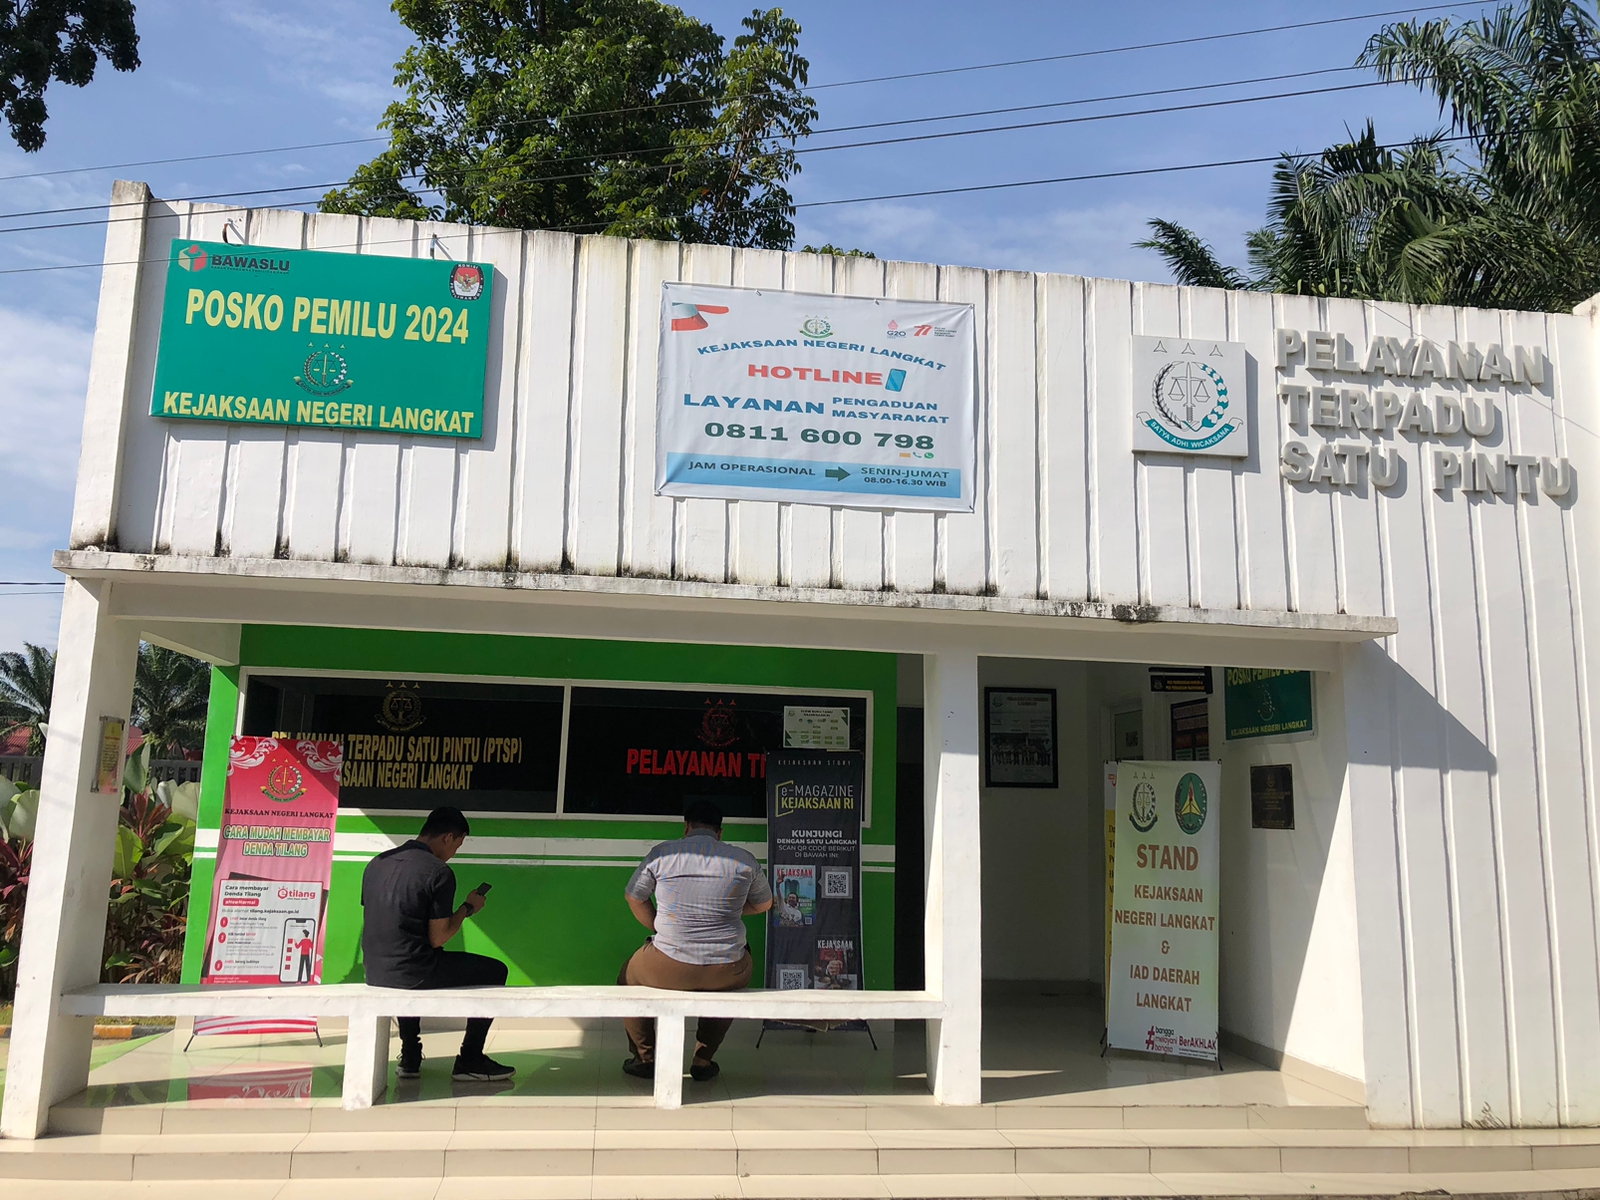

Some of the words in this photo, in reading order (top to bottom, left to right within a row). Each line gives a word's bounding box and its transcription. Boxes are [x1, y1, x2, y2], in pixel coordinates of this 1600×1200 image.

[212, 254, 290, 271] BAWASLU
[185, 288, 284, 331] POSKO
[292, 296, 397, 339] PEMILU
[404, 304, 468, 345] 2024
[697, 339, 798, 356] KEJAKSAAN
[803, 340, 866, 352] NEGERI
[870, 346, 946, 371] LANGKAT
[1274, 328, 1545, 384] PELAYANAN
[748, 364, 884, 386] HOTLINE
[684, 394, 825, 414] LAYANAN
[832, 397, 938, 410] PENGADUAN
[1276, 383, 1496, 437] TERPADU
[163, 391, 290, 422] KEJAKSAAN
[296, 400, 372, 428] NEGERI
[379, 406, 474, 434] LANGKAT
[832, 410, 950, 424] MASYARAKAT
[704, 422, 788, 442] 0811
[800, 428, 862, 446] 600
[874, 432, 935, 450] 798
[1150, 421, 1170, 440] SATYA
[1171, 437, 1189, 447] ADHI
[1190, 427, 1230, 448] WICAKSANA
[688, 461, 718, 471] JAM
[720, 462, 816, 476] OPERASIONAL
[860, 466, 950, 479] SENIN-JUMAT
[1280, 440, 1400, 488] SATU
[1432, 449, 1572, 497] PINTU
[864, 476, 923, 486] 08.00-16.30
[926, 478, 947, 487] WIB
[1231, 726, 1260, 736] KEJAKSAAN
[1260, 723, 1281, 733] NEGERI
[1282, 720, 1308, 730] LANGKAT
[348, 734, 404, 762] TERPADU
[407, 736, 438, 762] SATU
[442, 736, 480, 762] PINTU
[483, 737, 522, 764] (PTSP)
[626, 748, 742, 778] PELAYANAN
[376, 762, 418, 788] NEGERI
[420, 764, 473, 790] LANGKAT
[782, 785, 854, 797] e-MAGAZINE
[782, 797, 841, 809] KEJAKSAAN
[844, 798, 854, 809] RI
[224, 808, 270, 816] KEJAKSAAN
[224, 825, 249, 839] CARA
[250, 826, 282, 840] MUDAH
[282, 827, 331, 842] MEMBAYAR
[243, 842, 274, 856] DENDA
[275, 843, 308, 858] TILANG
[1136, 844, 1199, 872] STAND
[776, 868, 813, 878] KEJAKSAAN
[1134, 884, 1203, 903] KEJAKSAAN
[1114, 910, 1157, 927] NEGERI
[1160, 912, 1215, 931] LANGKAT
[817, 940, 853, 950] KEJAKSAAN
[1160, 940, 1170, 954] &
[1129, 964, 1149, 980] IAD
[1152, 966, 1200, 986] DAERAH
[1136, 992, 1192, 1012] LANGKAT
[1155, 1026, 1174, 1037] bangga
[1154, 1044, 1173, 1053] bangsa
[1155, 1036, 1177, 1045] melayani
[1179, 1036, 1216, 1050] BerAKHLAK
